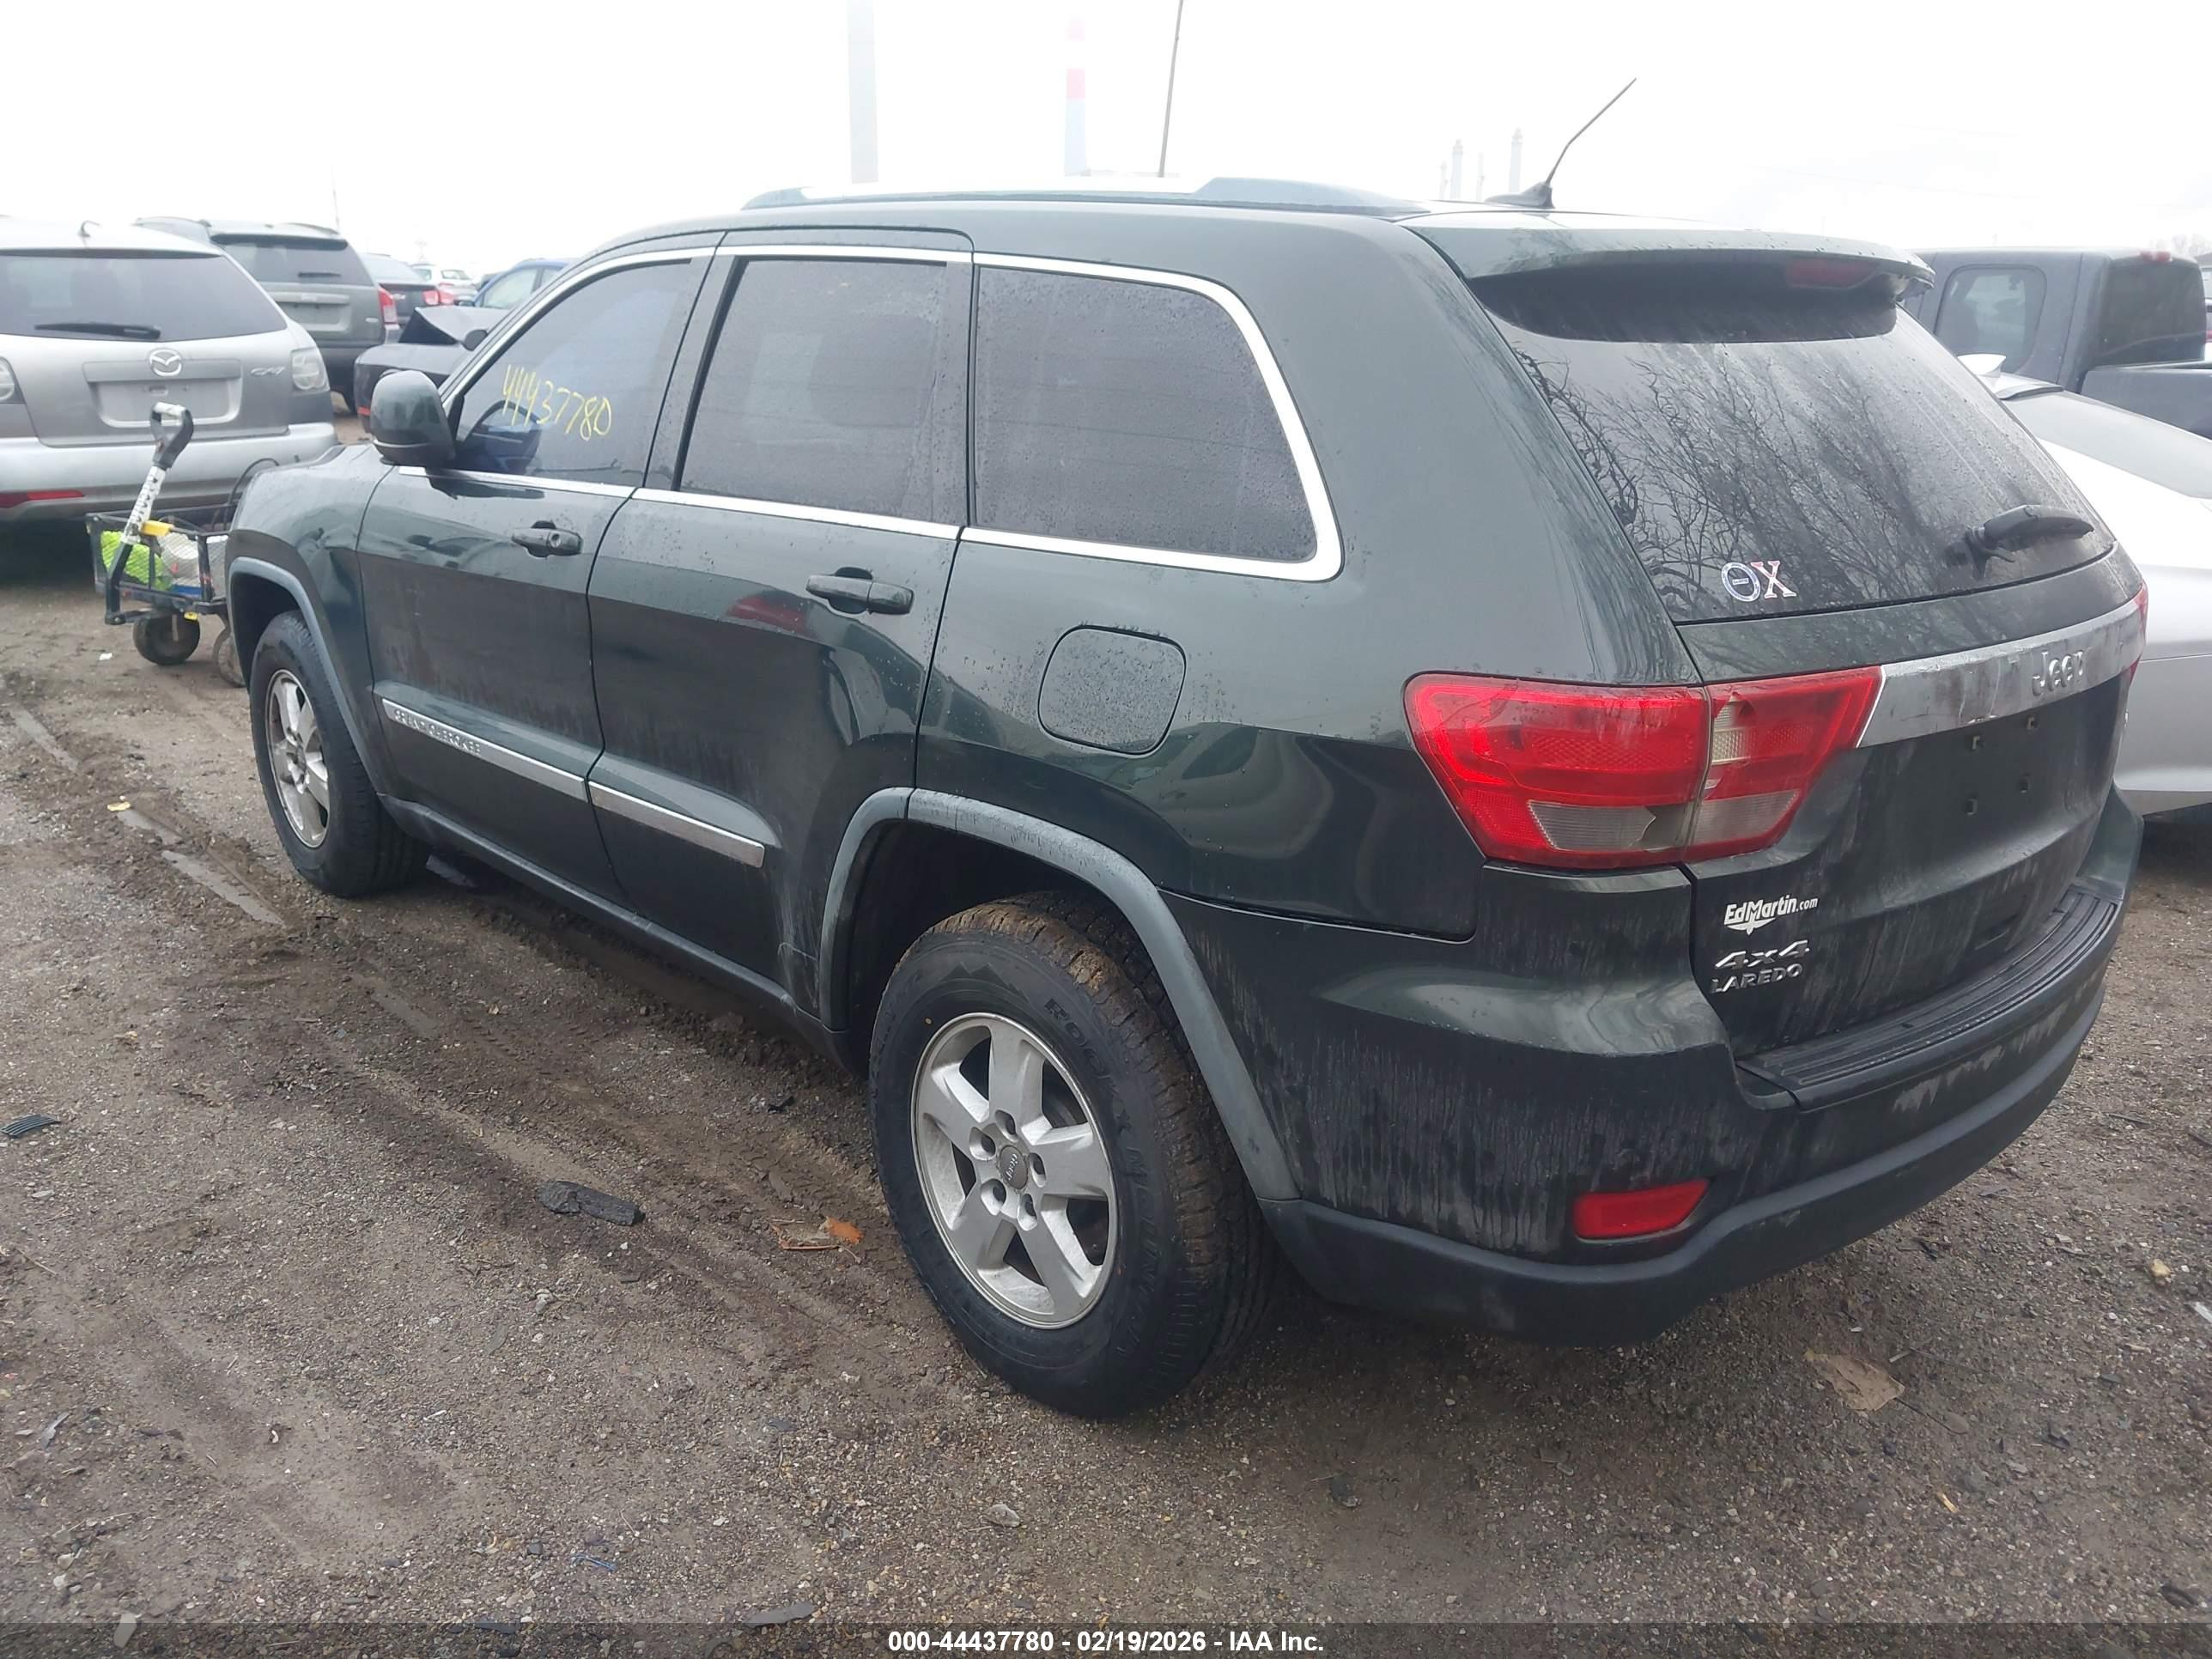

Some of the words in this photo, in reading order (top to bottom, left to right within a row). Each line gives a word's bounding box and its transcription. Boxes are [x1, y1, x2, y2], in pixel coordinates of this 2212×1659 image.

[502, 364, 612, 442] 44437780
[2032, 649, 2086, 696] Jeep
[1723, 894, 1819, 928] EdMartin.com
[1715, 939, 1810, 969] 4x4
[1711, 963, 1803, 994] LAREDO
